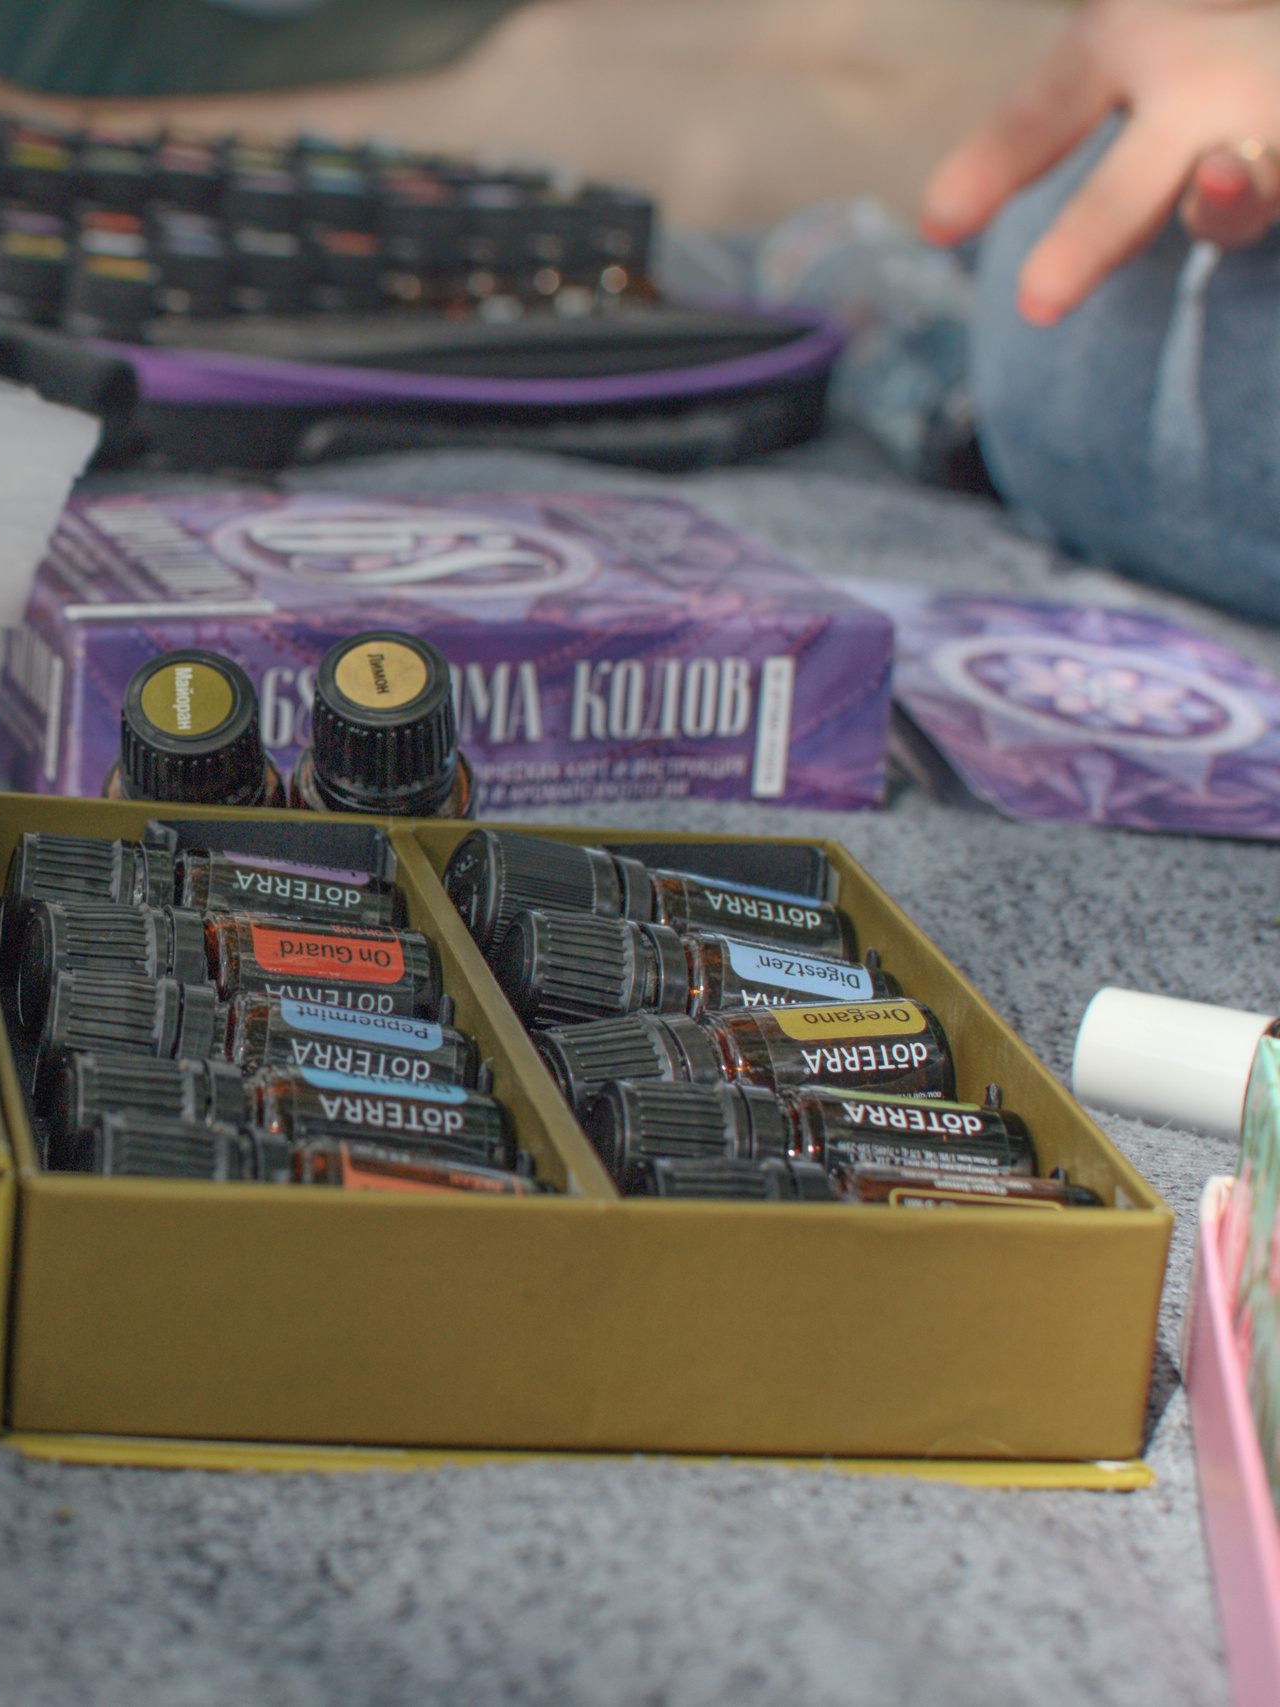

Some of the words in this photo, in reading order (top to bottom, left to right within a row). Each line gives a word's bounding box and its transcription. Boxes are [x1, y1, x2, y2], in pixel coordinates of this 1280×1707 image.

[172, 667, 193, 730] Майоран
[571, 656, 751, 742] КОДОВ
[280, 940, 353, 965] Guard
[359, 947, 392, 968] On
[759, 955, 860, 990] DigestZen
[296, 1004, 429, 1040] Peppermint
[803, 1008, 910, 1024] Oregano
